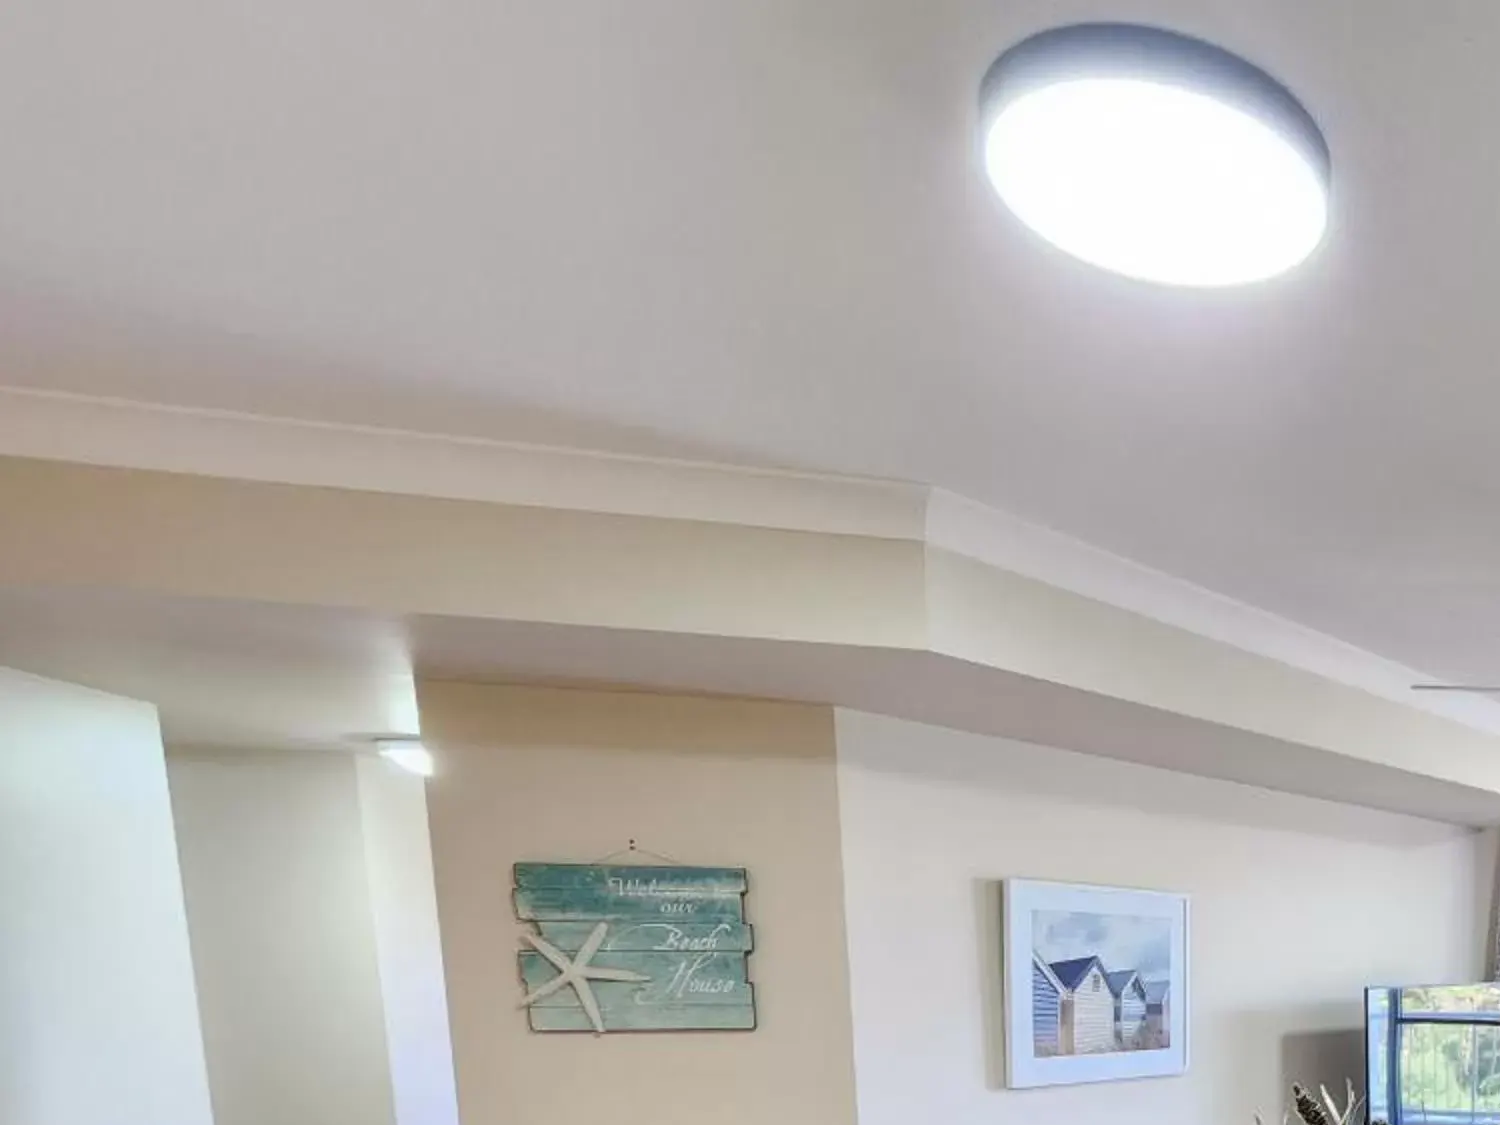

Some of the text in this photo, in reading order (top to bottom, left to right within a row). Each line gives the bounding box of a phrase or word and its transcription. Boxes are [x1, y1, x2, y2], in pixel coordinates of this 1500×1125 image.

[659, 902, 698, 914] our
[642, 923, 731, 951] Beach
[659, 952, 736, 998] House
